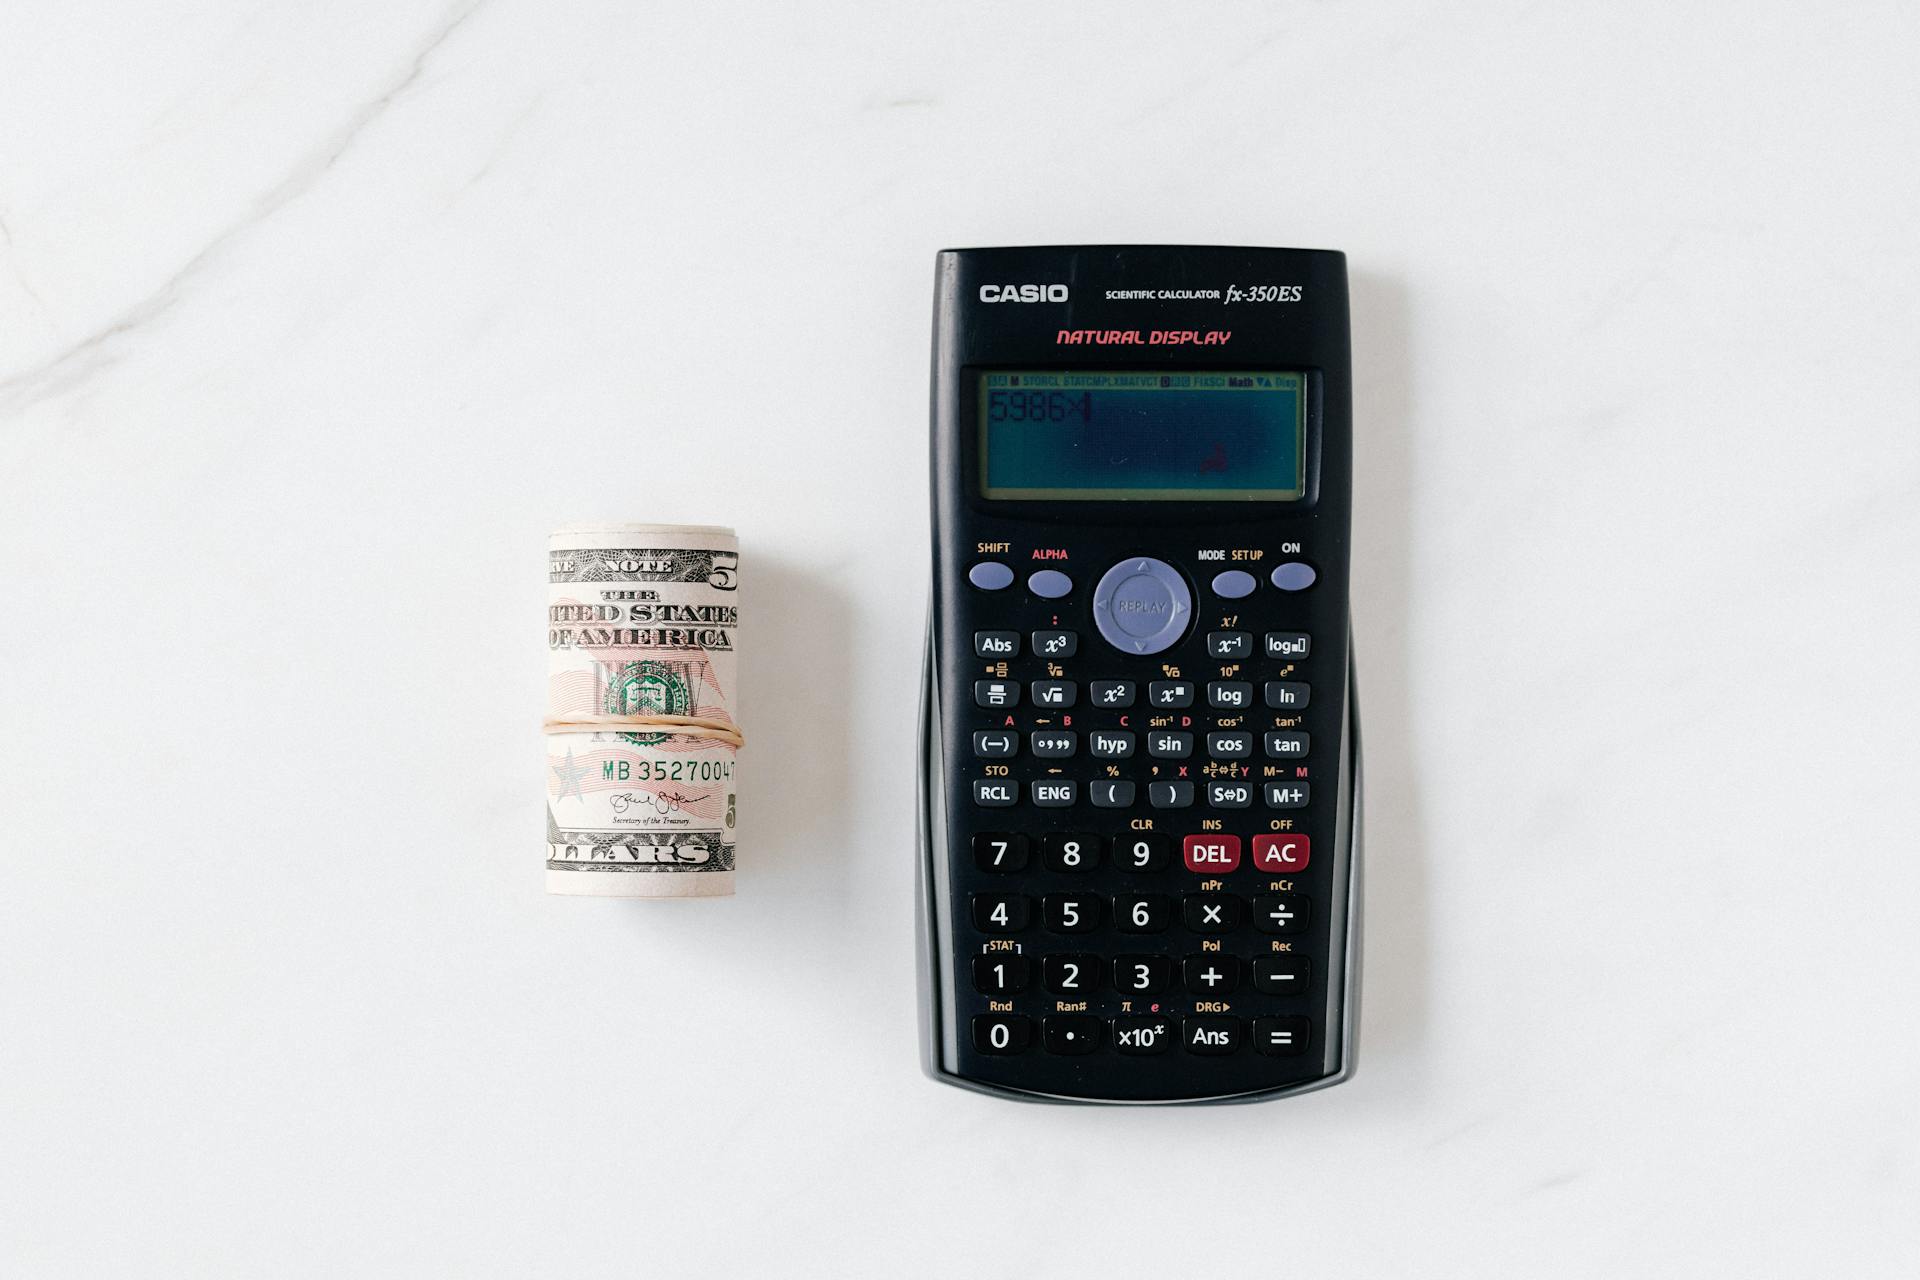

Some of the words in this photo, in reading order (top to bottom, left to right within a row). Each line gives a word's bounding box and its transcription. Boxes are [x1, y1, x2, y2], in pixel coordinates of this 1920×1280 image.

[980, 285, 1068, 302] CASIO
[1106, 291, 1155, 299] SCIENTIFIC
[1158, 290, 1220, 299] CALCULATOR
[1224, 285, 1302, 304] fx-350ES
[1057, 331, 1144, 344] NATURAL
[1149, 331, 1231, 344] DISPLAY
[978, 543, 1010, 552] SHIFT
[1282, 543, 1300, 553] ON
[1033, 550, 1068, 559] ALPHA
[1199, 550, 1225, 560] MODE
[604, 560, 673, 573] NOTE
[709, 556, 737, 591] 5
[601, 590, 660, 602] THE
[1119, 601, 1167, 613] REPLAY
[630, 605, 737, 627] STATES
[577, 629, 733, 651] AMERICA
[982, 638, 1011, 651] Abs
[1218, 688, 1241, 705] log
[1005, 716, 1014, 725] A
[1064, 716, 1071, 725] B
[1120, 716, 1128, 726] C
[1183, 717, 1191, 726] D
[1098, 736, 1127, 753] hyp
[1159, 736, 1181, 750] sin
[1217, 740, 1242, 751] cos
[1274, 739, 1300, 751] tan
[603, 761, 630, 780] MB
[986, 766, 1008, 775] STO
[1180, 767, 1187, 776] X
[1241, 767, 1248, 776] Y
[1297, 767, 1307, 777] M
[981, 787, 1010, 799] RCL
[1039, 787, 1070, 799] ENG
[1274, 789, 1302, 802] M+
[1131, 820, 1152, 829] CLR
[1203, 820, 1221, 829] INS
[1271, 820, 1292, 829] OFF
[992, 842, 1007, 865] 7
[1064, 842, 1080, 865] 8
[1134, 842, 1149, 866] 9
[1194, 845, 1231, 862] DEL
[1266, 844, 1295, 862] AC
[1202, 880, 1222, 890] nPr
[1271, 880, 1293, 890] nCr
[991, 903, 1008, 925] 4
[1064, 903, 1078, 926] 5
[1133, 902, 1149, 926] 6
[988, 941, 1014, 950] STAT
[1203, 941, 1220, 951] Pol
[1273, 941, 1291, 951] Rec
[994, 965, 1003, 987] 1
[1063, 964, 1078, 987] 2
[1134, 965, 1149, 988] 3
[991, 1001, 1012, 1011] Rnd
[1057, 1002, 1086, 1011] Ran#
[1151, 1004, 1159, 1012] e
[991, 1024, 1009, 1048] 0
[1193, 1028, 1229, 1044] Ans
